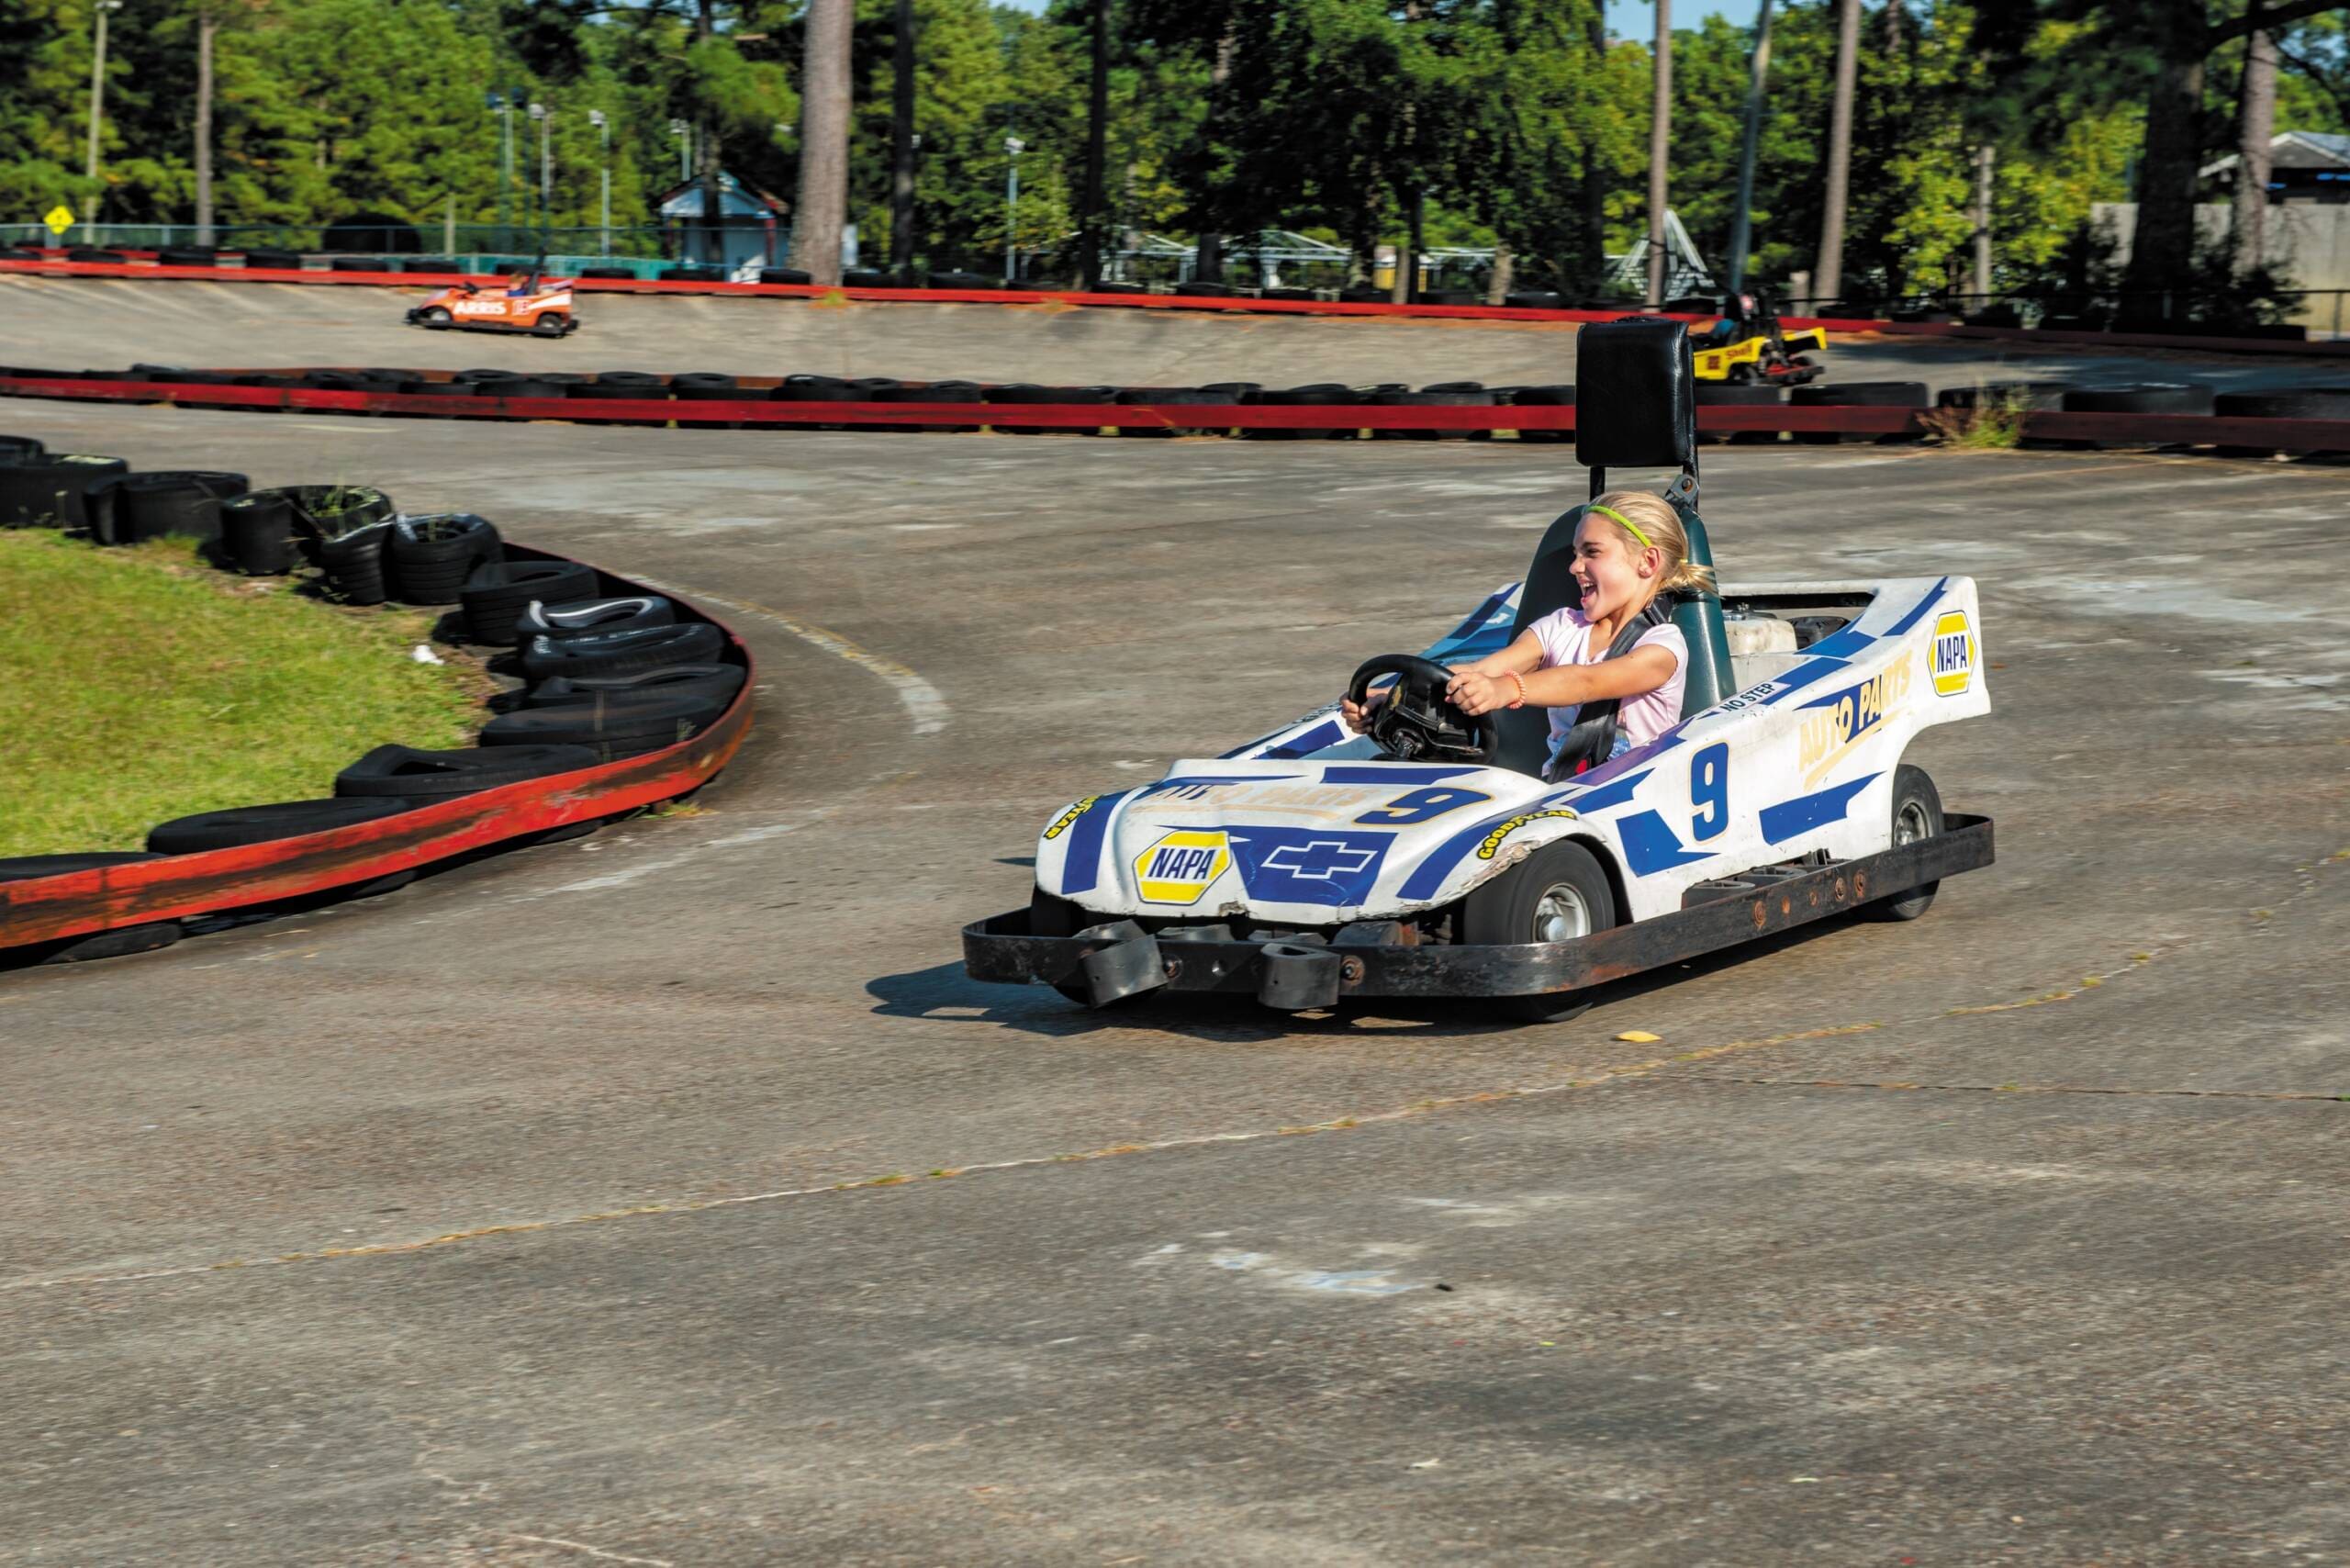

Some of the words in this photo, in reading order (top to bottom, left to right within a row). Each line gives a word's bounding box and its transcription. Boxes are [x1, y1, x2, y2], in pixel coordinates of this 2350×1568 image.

[1936, 634, 1968, 673] NAPA
[1719, 700, 1746, 711] NO
[1740, 683, 1775, 702] STEP
[1798, 695, 1853, 773] AUTO
[1858, 649, 1913, 730] PARTS
[1353, 788, 1494, 825] 9
[1688, 740, 1730, 844] 9
[1476, 810, 1578, 859] GOODYEAR
[1147, 847, 1219, 879] NAPA
